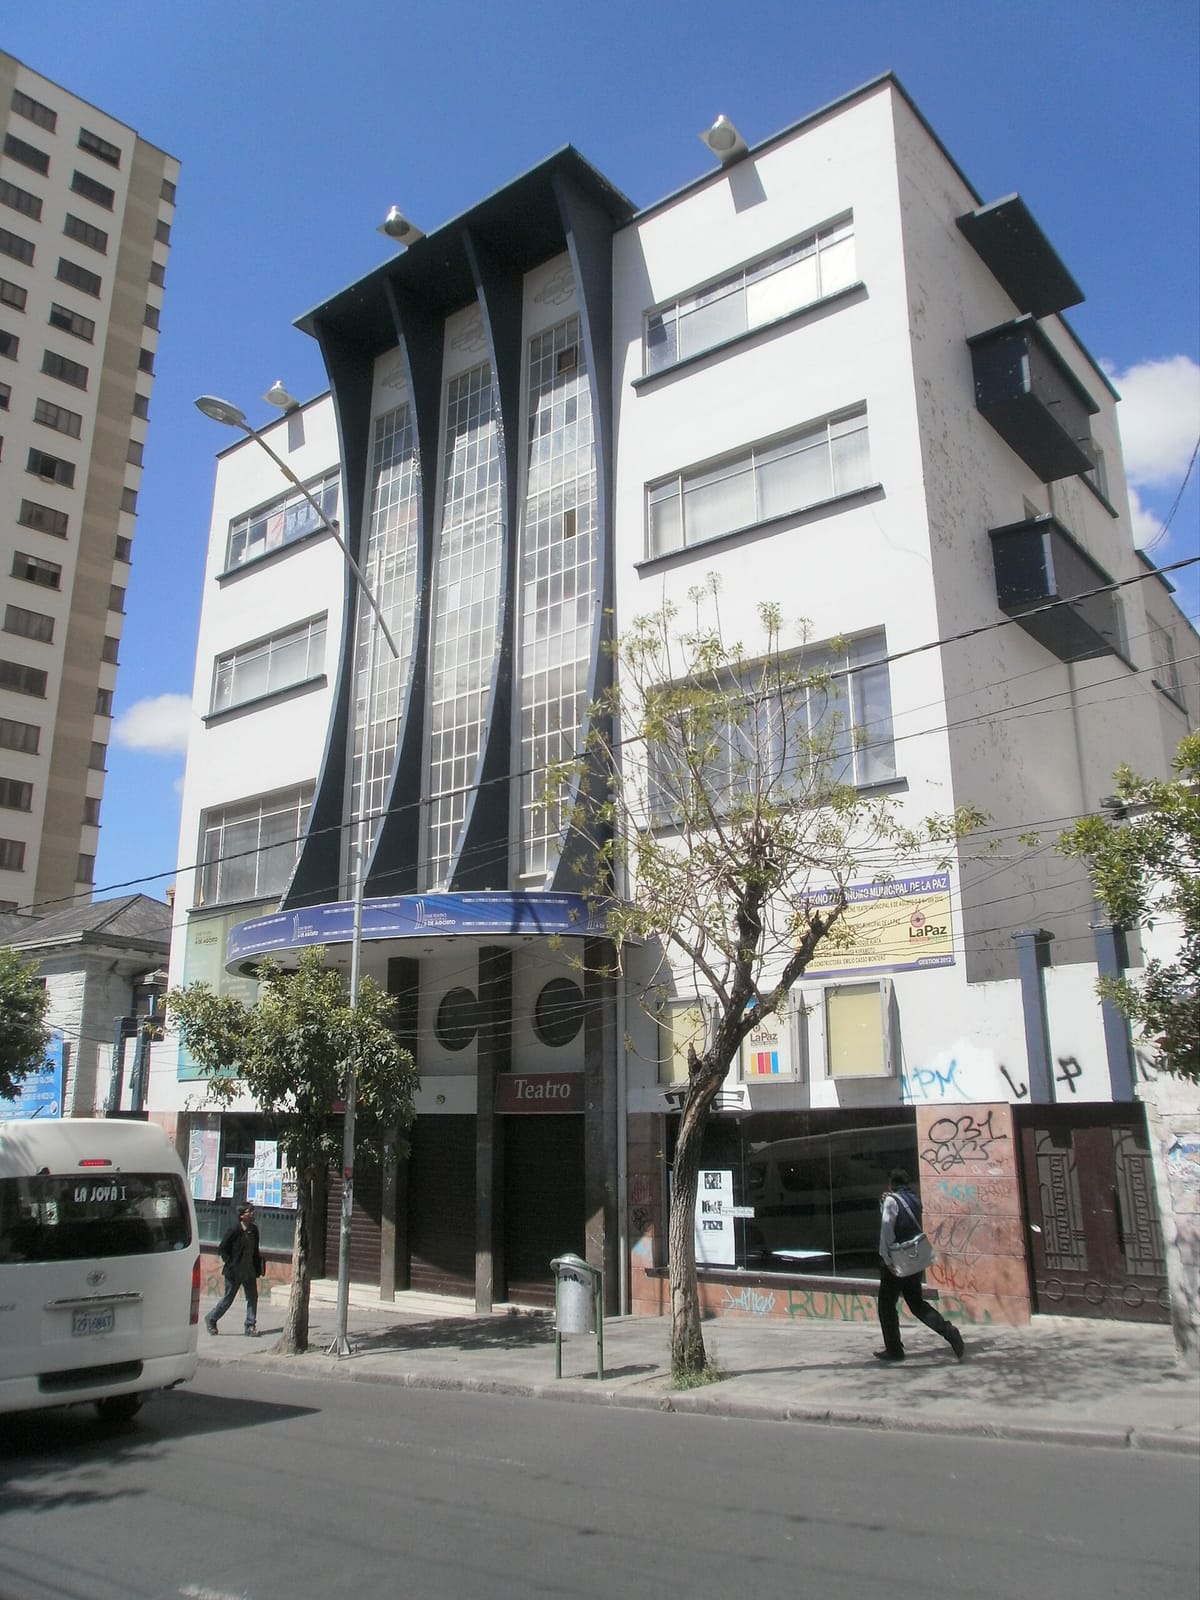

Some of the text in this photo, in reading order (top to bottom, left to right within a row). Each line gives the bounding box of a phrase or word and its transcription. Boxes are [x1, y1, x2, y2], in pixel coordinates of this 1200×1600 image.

[921, 880, 932, 891] LA
[932, 877, 947, 889] PAZ
[514, 1079, 571, 1099] Teatro
[74, 1186, 87, 1203] LA
[90, 1185, 118, 1202] JOYA
